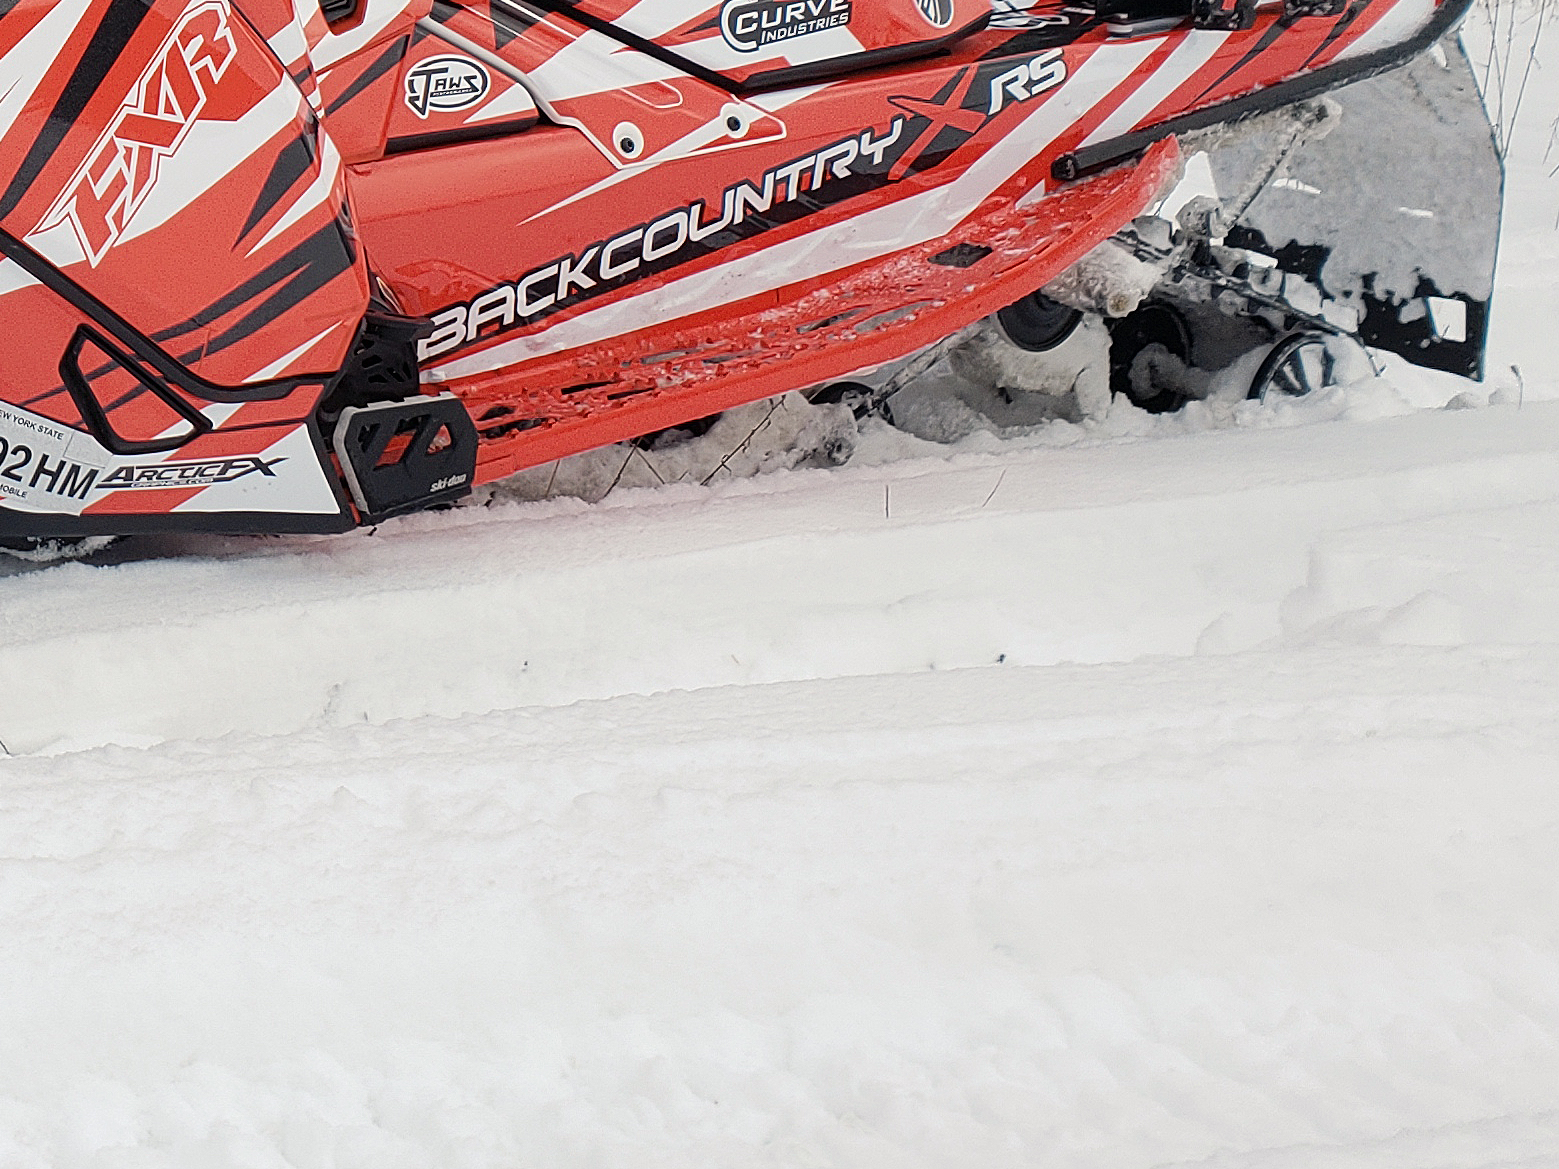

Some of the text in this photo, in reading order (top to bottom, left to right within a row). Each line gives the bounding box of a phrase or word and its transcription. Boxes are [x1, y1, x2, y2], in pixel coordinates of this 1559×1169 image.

[761, 12, 849, 43] INDUSTRIES
[409, 67, 480, 116] JAWS
[23, 0, 237, 268] FXR
[417, 118, 903, 362] BACKCOUNTRY
[11, 414, 36, 431] YORK
[38, 424, 64, 441] STATE
